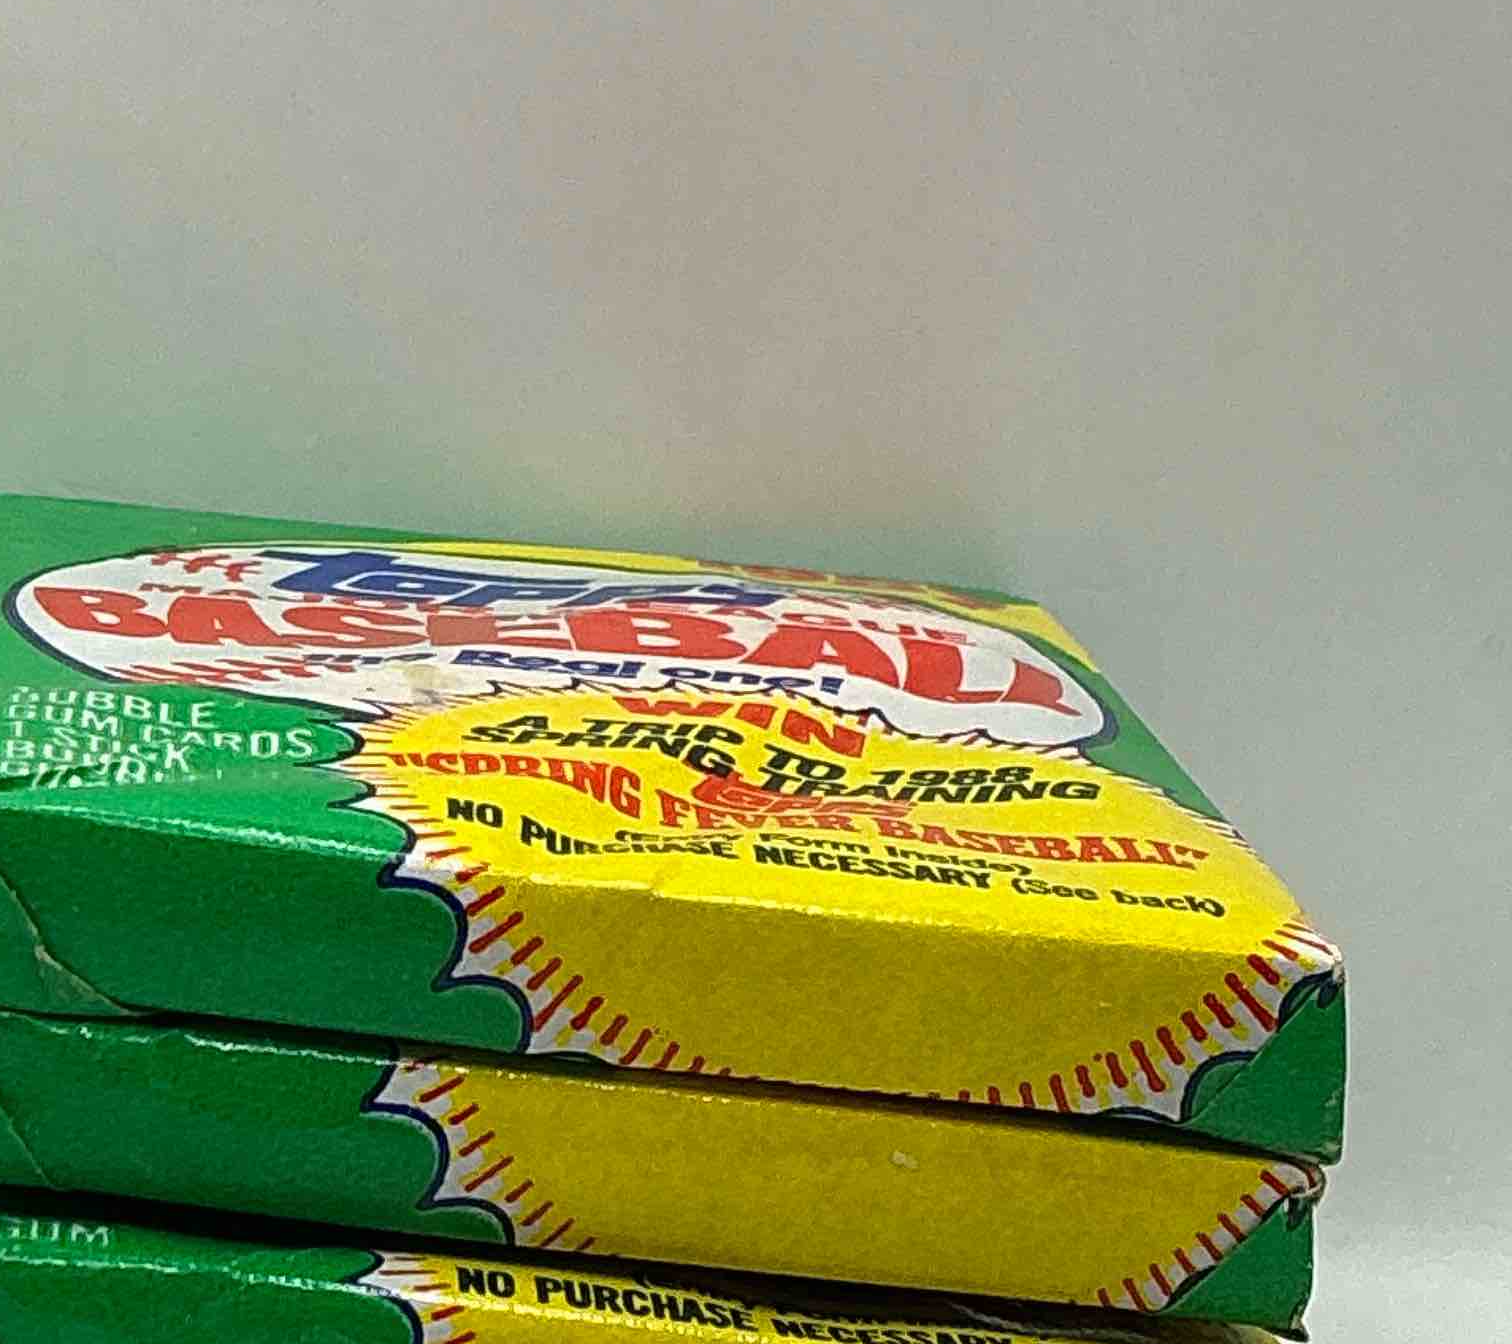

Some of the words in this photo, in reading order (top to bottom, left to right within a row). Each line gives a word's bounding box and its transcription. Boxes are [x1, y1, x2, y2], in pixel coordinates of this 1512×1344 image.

[33, 587, 1082, 716] BASEBALL
[450, 650, 646, 679] Real
[659, 666, 845, 696] one!
[8, 704, 120, 737] GUM
[497, 715, 550, 731] A
[582, 717, 745, 746] TRIP
[762, 743, 847, 780] TO
[873, 766, 1035, 788] 1988
[610, 695, 866, 757] WIN
[461, 726, 738, 775] SPRING
[757, 766, 1102, 803] TRAINING
[656, 788, 867, 833] FEVER
[445, 797, 504, 829] NO
[520, 815, 741, 860] PURCHASE
[754, 844, 992, 890] NECESSARY
[1010, 876, 1100, 902] (See
[1110, 888, 1228, 919] back)
[757, 832, 872, 856] Form
[455, 1265, 516, 1298] NO
[535, 1275, 759, 1332] PURCHASE
